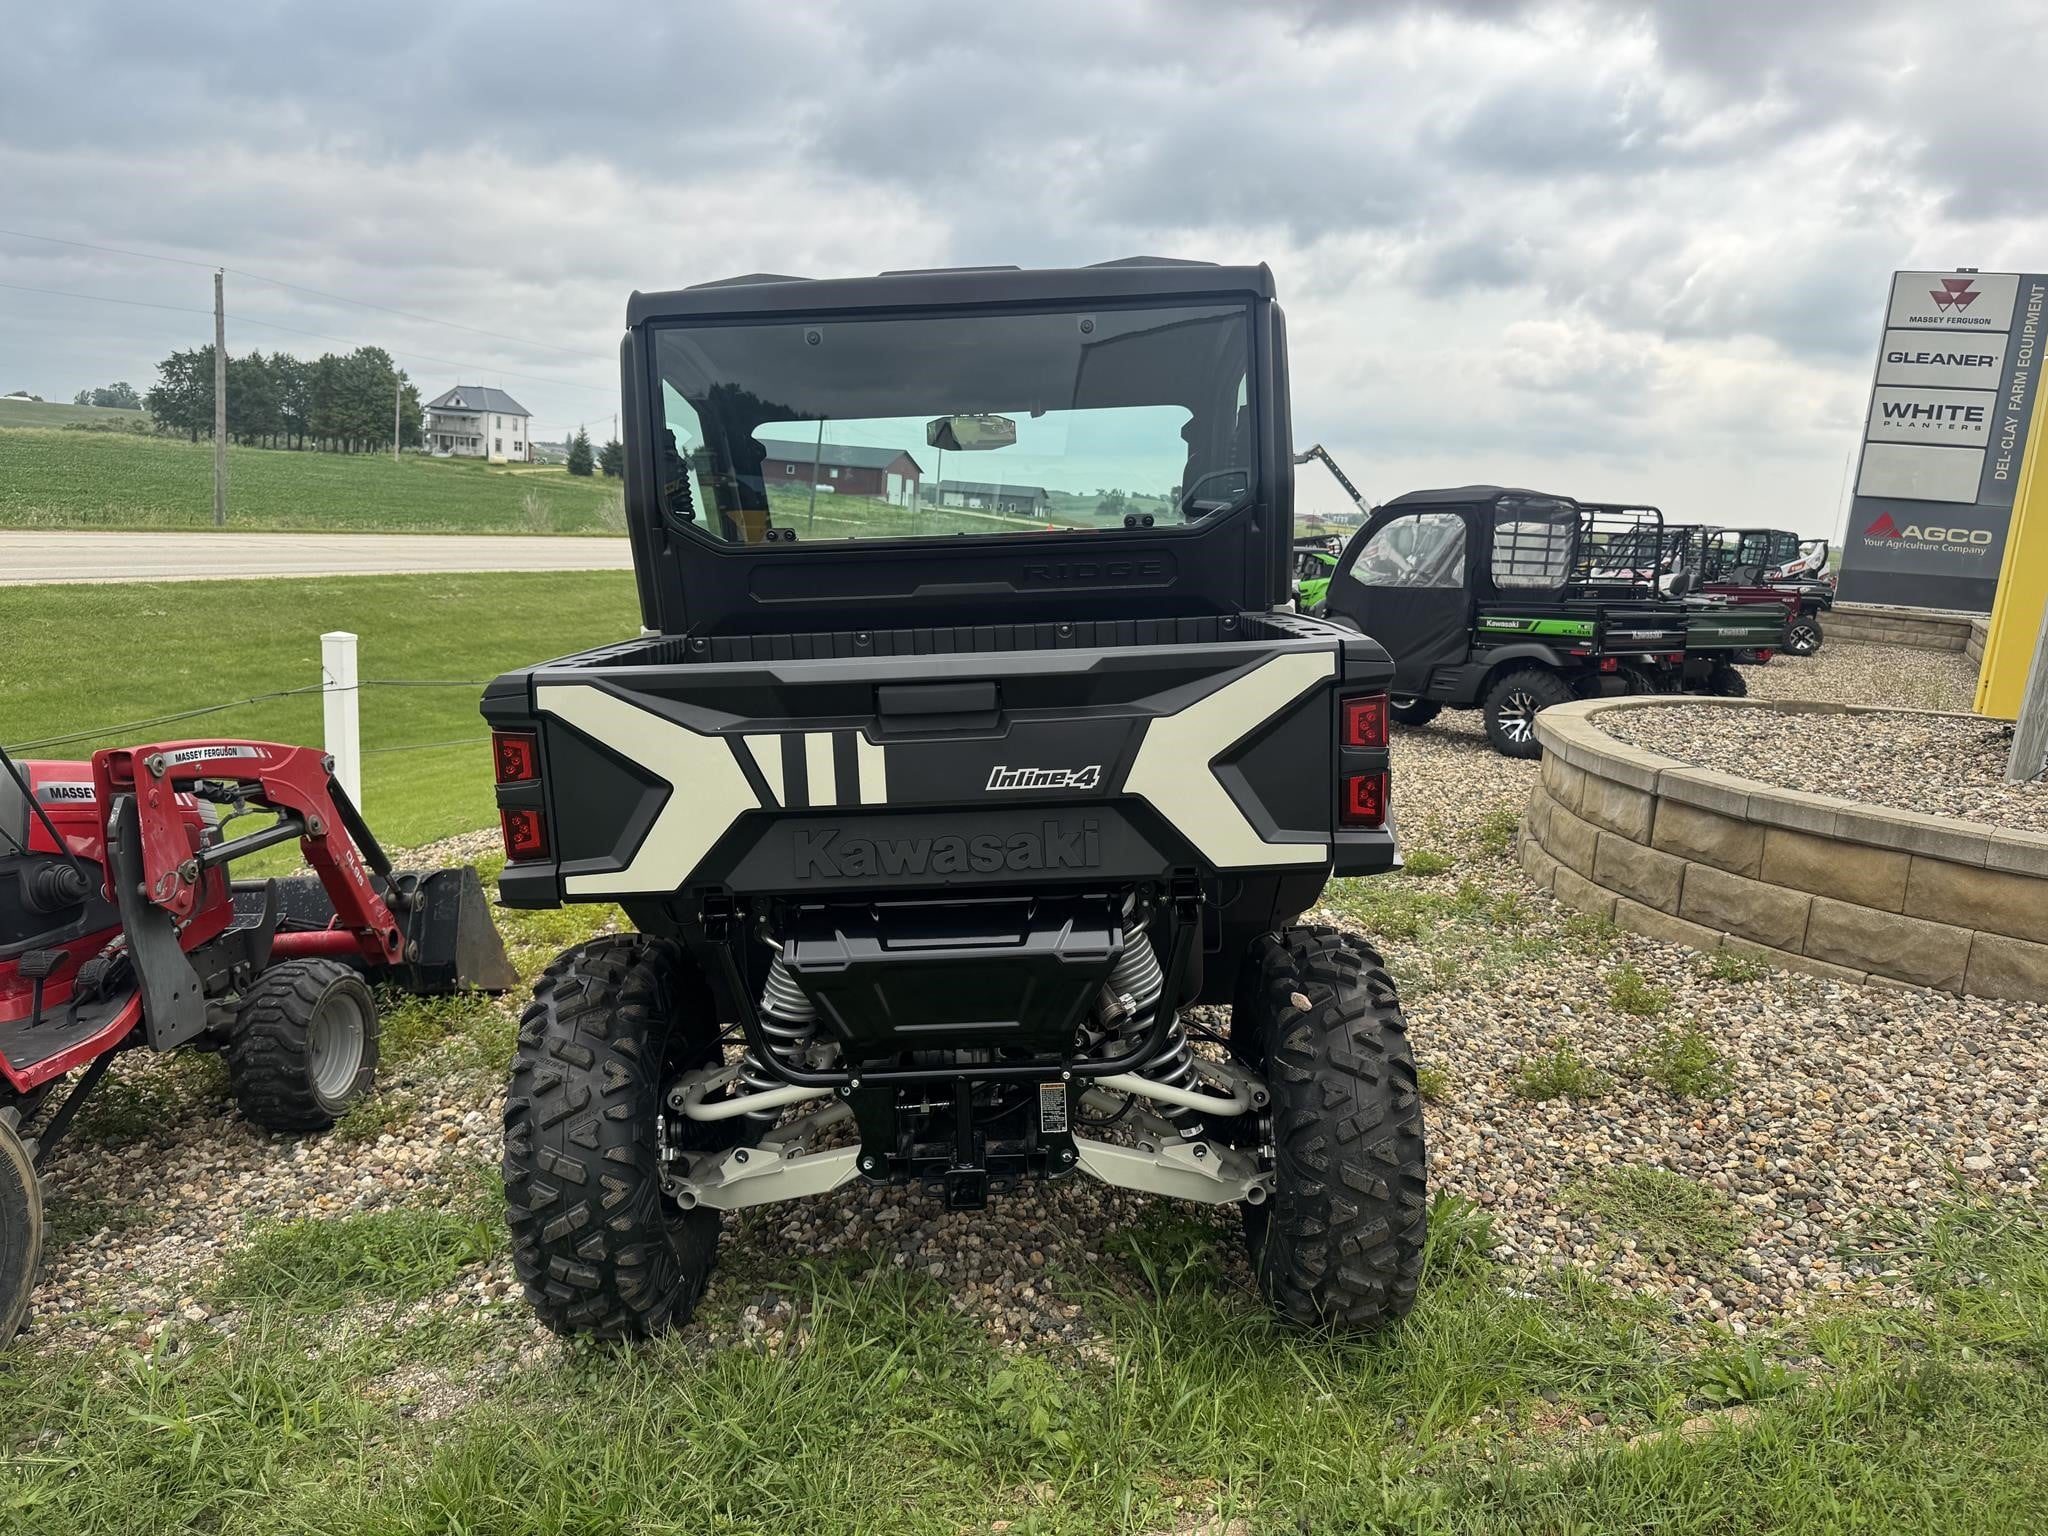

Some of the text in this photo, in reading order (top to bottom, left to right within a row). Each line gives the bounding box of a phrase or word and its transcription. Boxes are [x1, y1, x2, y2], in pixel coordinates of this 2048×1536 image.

[1909, 316, 1991, 325] MASSEY FERGUSON
[1887, 352, 1994, 367] GLEANER
[1994, 284, 2045, 480] DEL-CLAY FARM EQUIPMENT
[1882, 402, 1984, 422] WHITE
[1883, 421, 1982, 431] PLANTERS
[1902, 525, 1992, 545] AGCO
[1864, 538, 1986, 556] Your Agriculture Company
[1024, 560, 1161, 580] RIDGE
[1486, 619, 1520, 628] Kawasaki
[175, 747, 238, 762] MASSEY FERGUSON
[985, 765, 1101, 791] Inline-4
[794, 818, 1099, 879] Kawasaki
